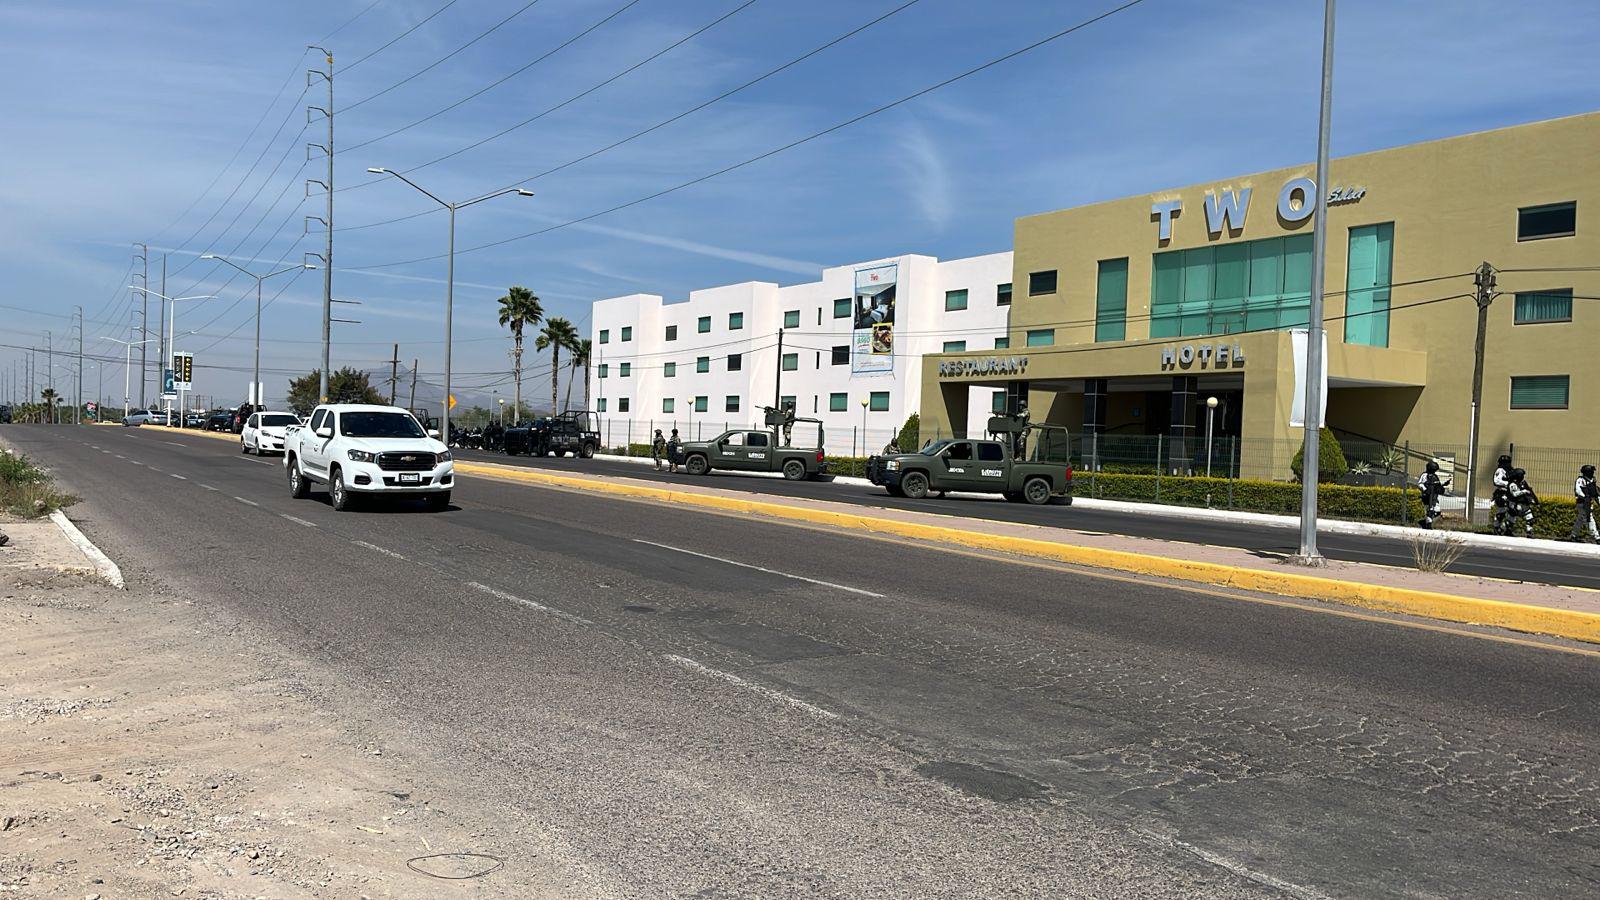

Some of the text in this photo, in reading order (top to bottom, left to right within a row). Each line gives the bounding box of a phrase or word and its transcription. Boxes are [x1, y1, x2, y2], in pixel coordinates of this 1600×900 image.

[1151, 178, 1317, 243] TWO
[939, 357, 1028, 376] RESTAURANT
[1161, 344, 1246, 368] HOTEL
